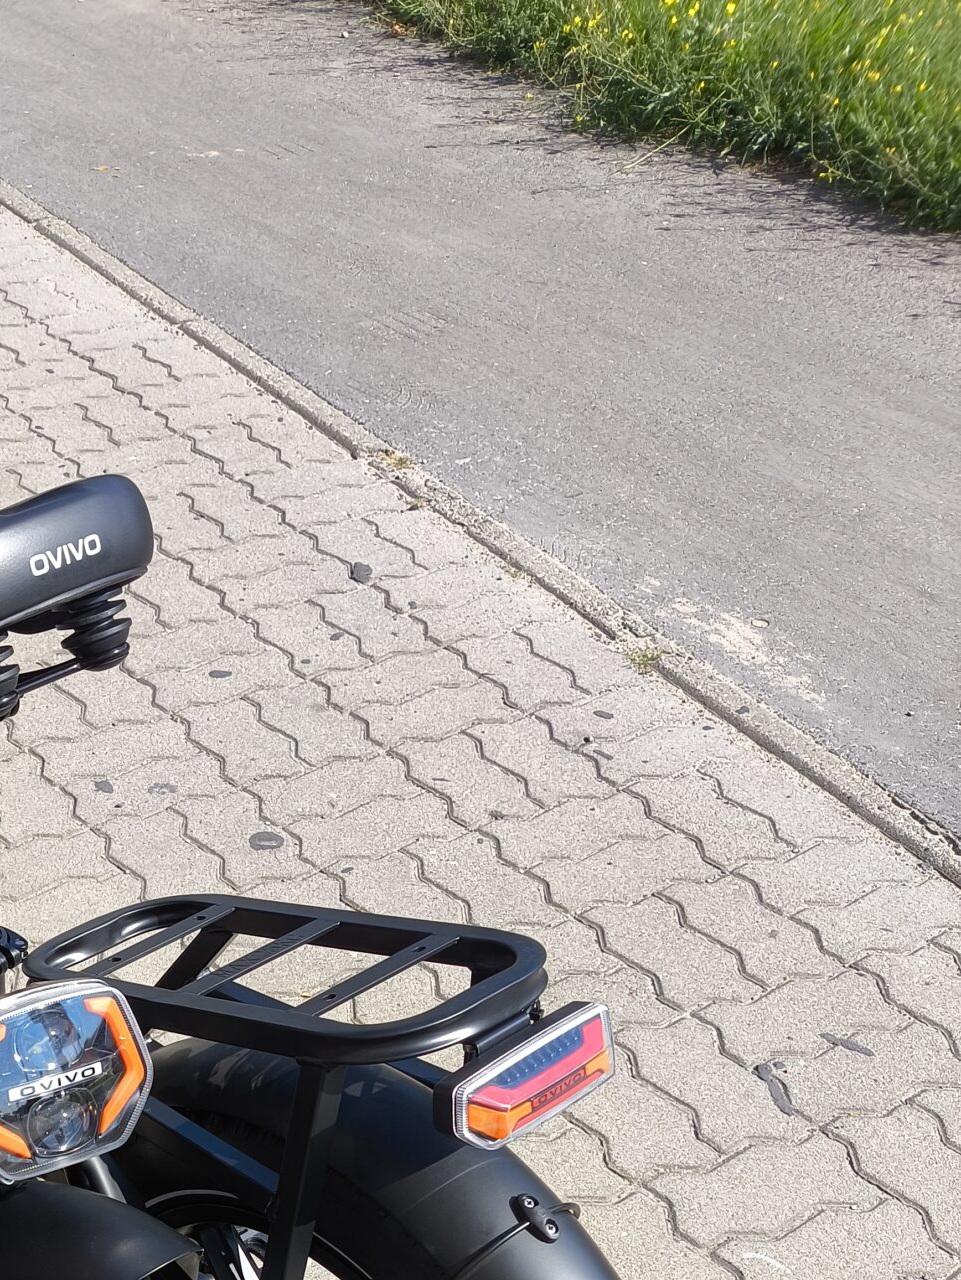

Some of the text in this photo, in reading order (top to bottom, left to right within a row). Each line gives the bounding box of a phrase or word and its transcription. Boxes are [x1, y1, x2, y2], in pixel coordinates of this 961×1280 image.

[29, 533, 102, 577] OVIVO
[19, 1066, 96, 1097] OVIVO
[538, 1071, 585, 1105] OVIVO
